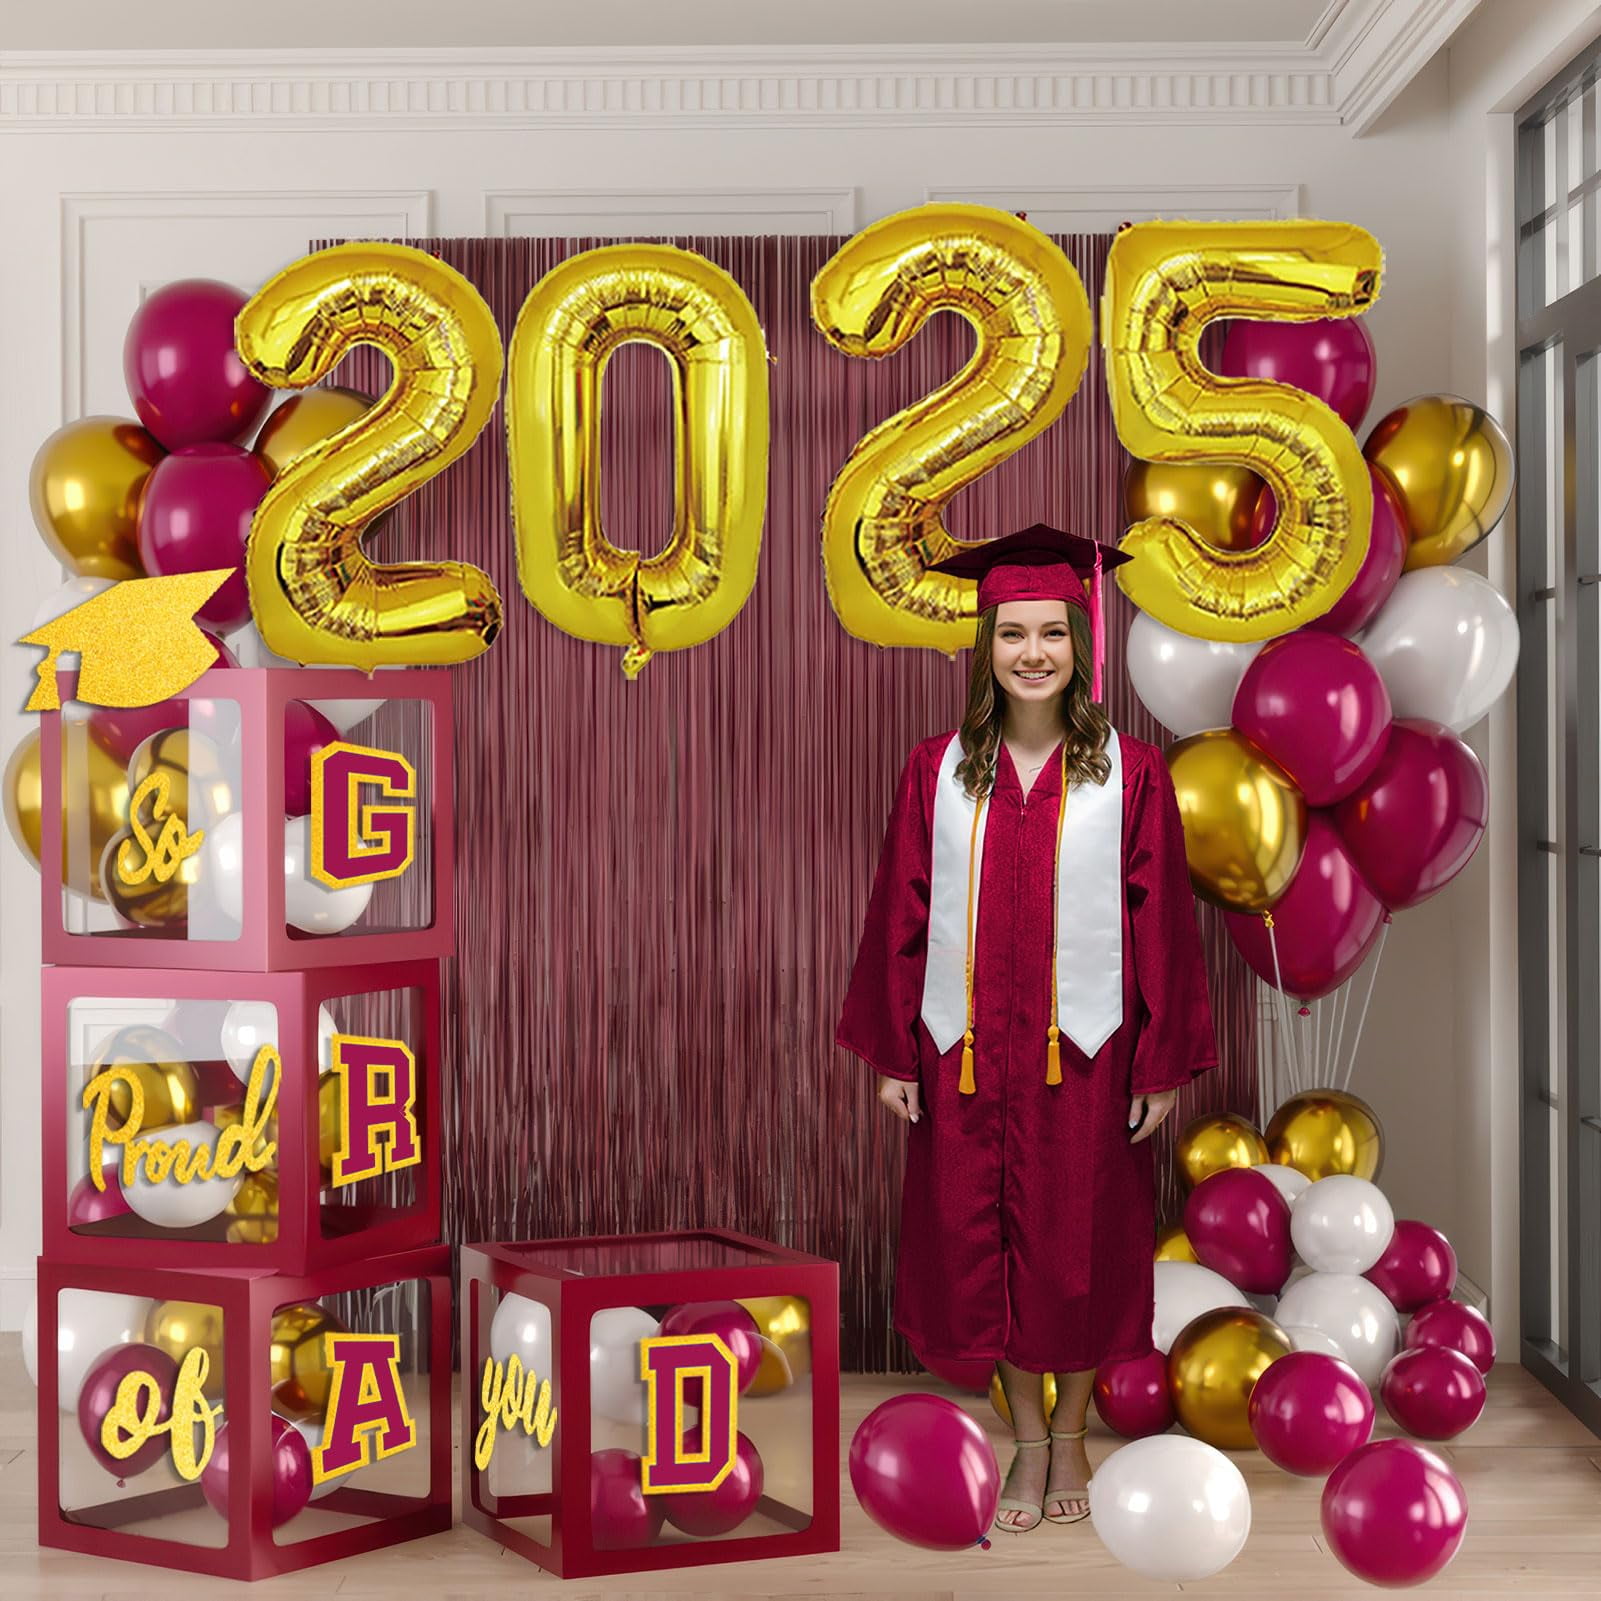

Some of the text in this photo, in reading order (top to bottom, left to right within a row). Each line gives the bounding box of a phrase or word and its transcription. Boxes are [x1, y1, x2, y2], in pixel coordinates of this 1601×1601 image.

[235, 202, 1386, 672] 2025
[118, 772, 204, 885] So
[311, 741, 416, 889] G
[82, 1043, 282, 1192] Proud
[332, 1033, 421, 1188] R
[100, 1347, 222, 1481] of
[312, 1332, 417, 1485] A
[474, 1353, 557, 1471] you
[641, 1334, 739, 1495] D
